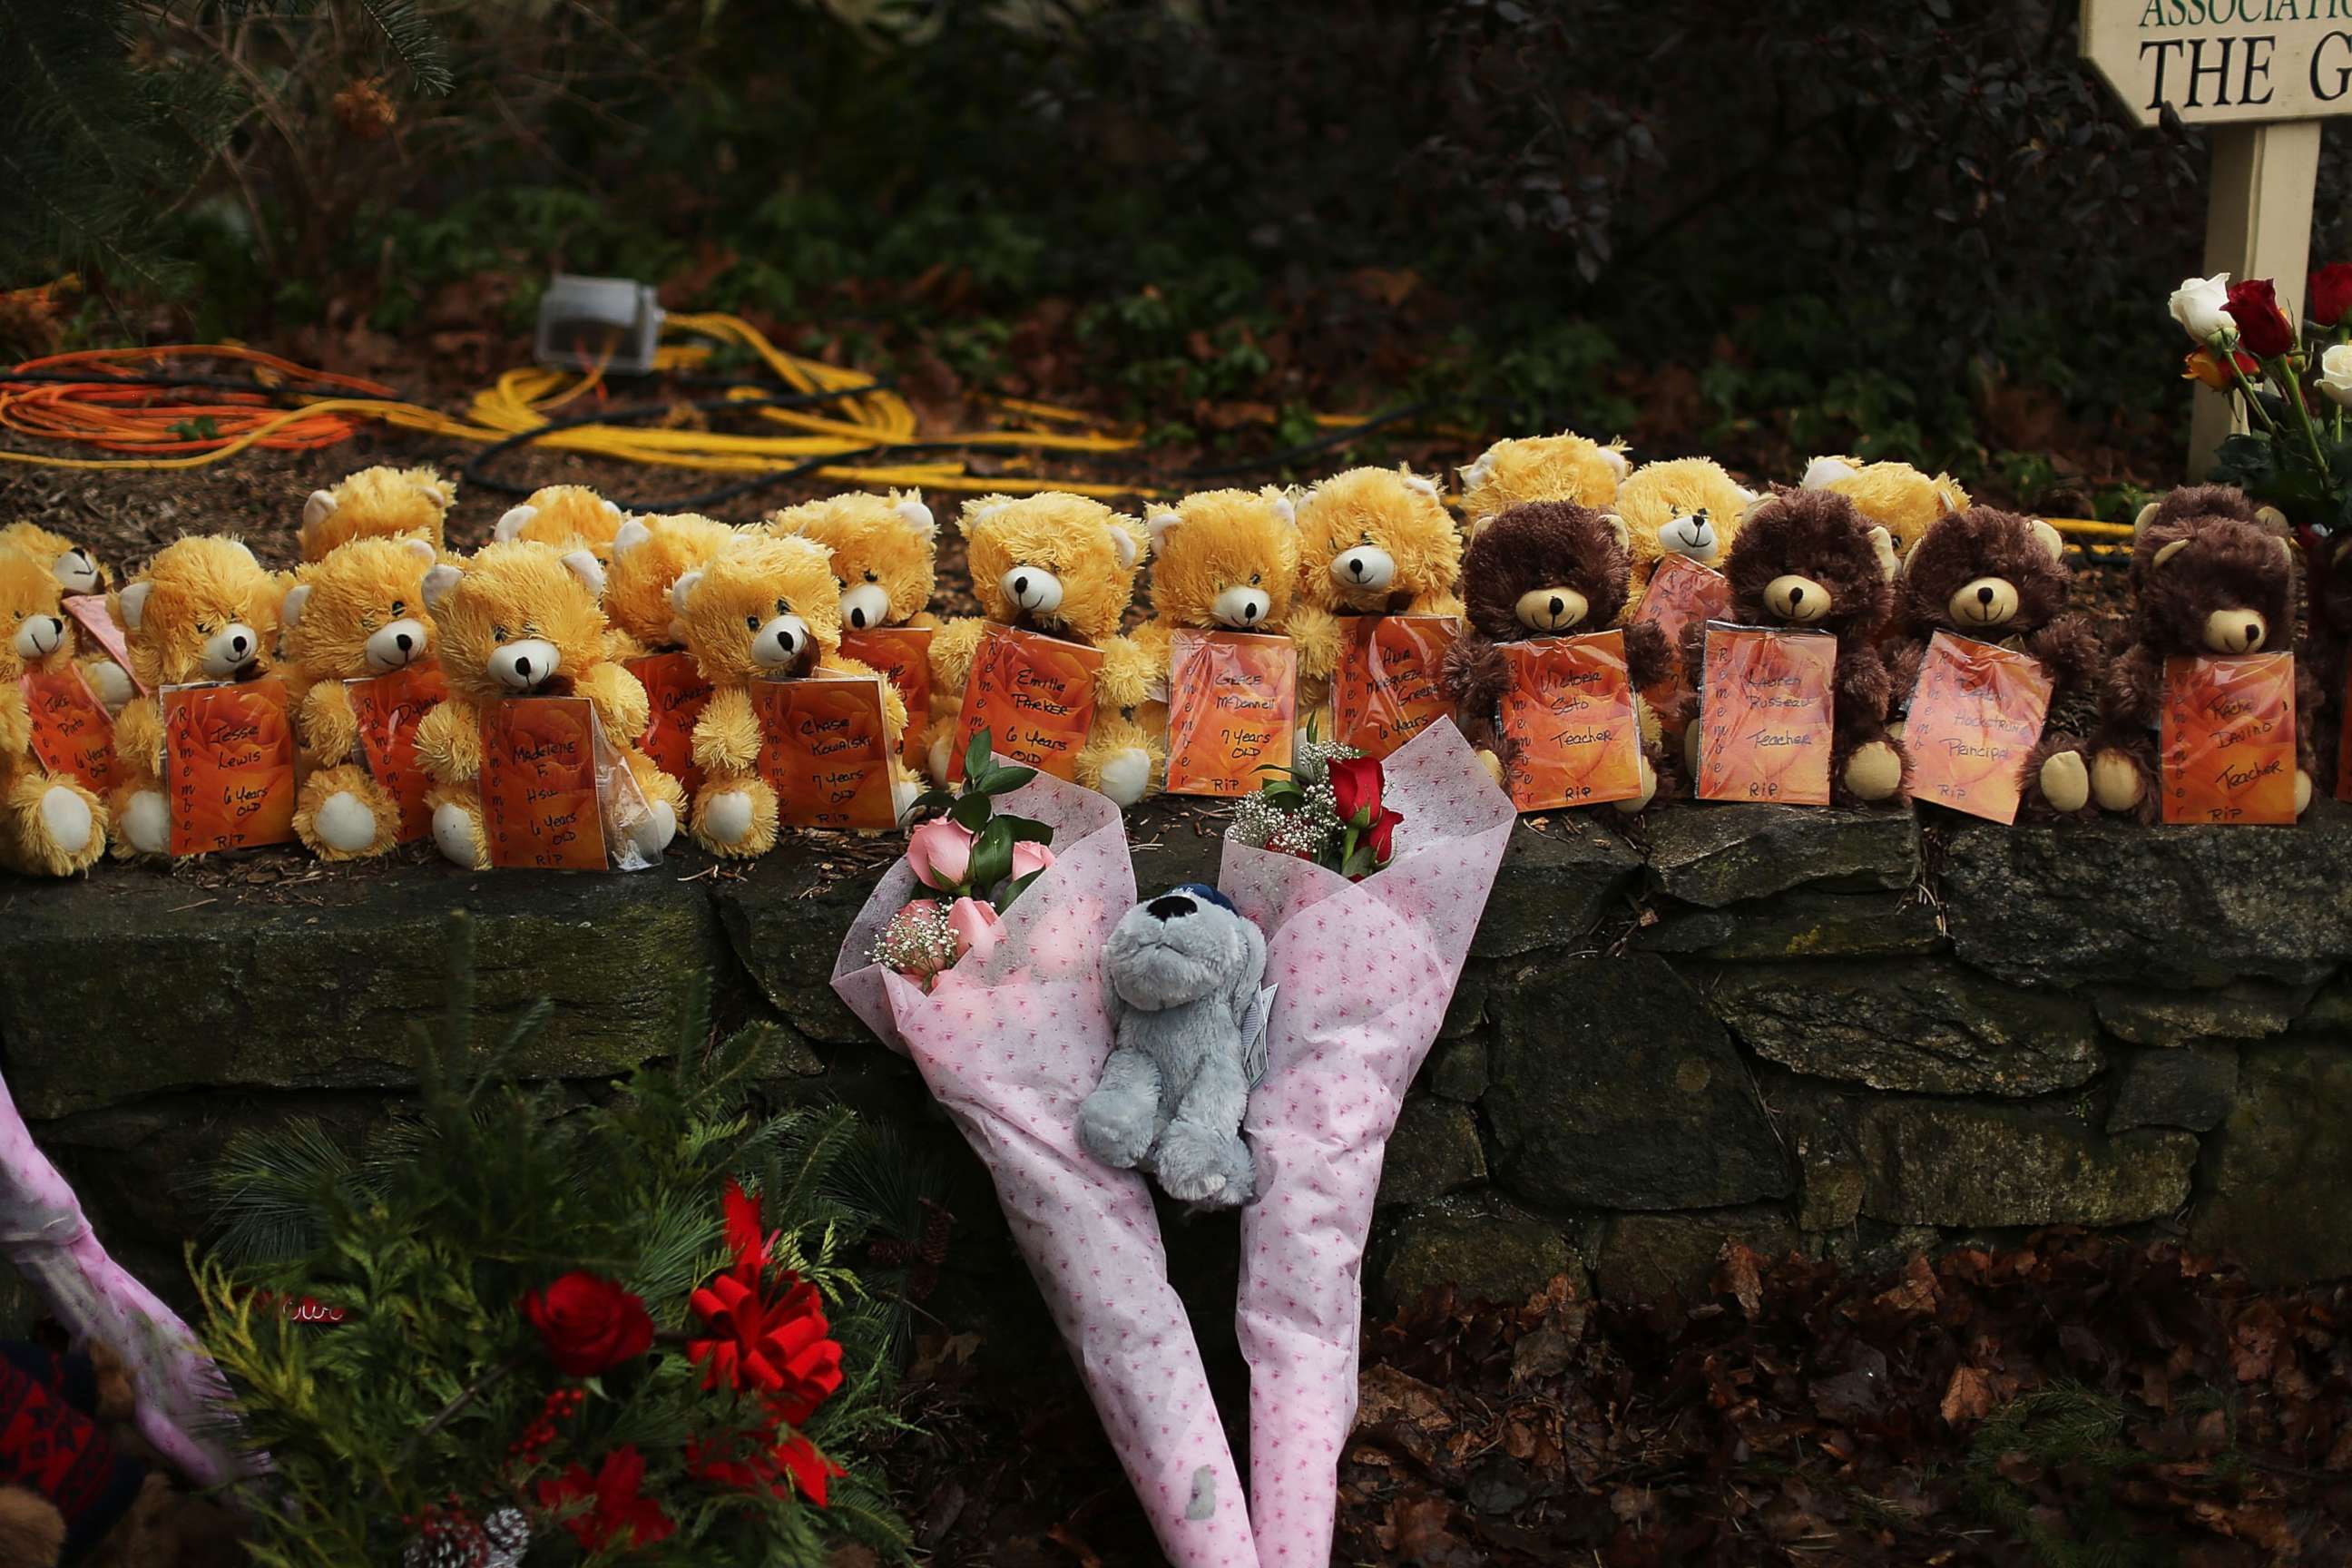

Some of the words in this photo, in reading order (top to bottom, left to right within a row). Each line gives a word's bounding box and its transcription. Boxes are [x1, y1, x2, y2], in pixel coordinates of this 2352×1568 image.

[2138, 0, 2352, 27] ASSOCIATI
[2139, 35, 2276, 111] THE
[1549, 696, 1590, 717] Soto
[800, 717, 851, 736] Chase
[1180, 652, 1196, 786] emember
[210, 724, 260, 744] Jesse
[1004, 725, 1018, 742] 6
[1024, 729, 1068, 751] Years
[1232, 729, 1271, 744] Years
[217, 750, 261, 770] Lewis
[1231, 746, 1261, 760] OLD
[223, 786, 232, 806] 6
